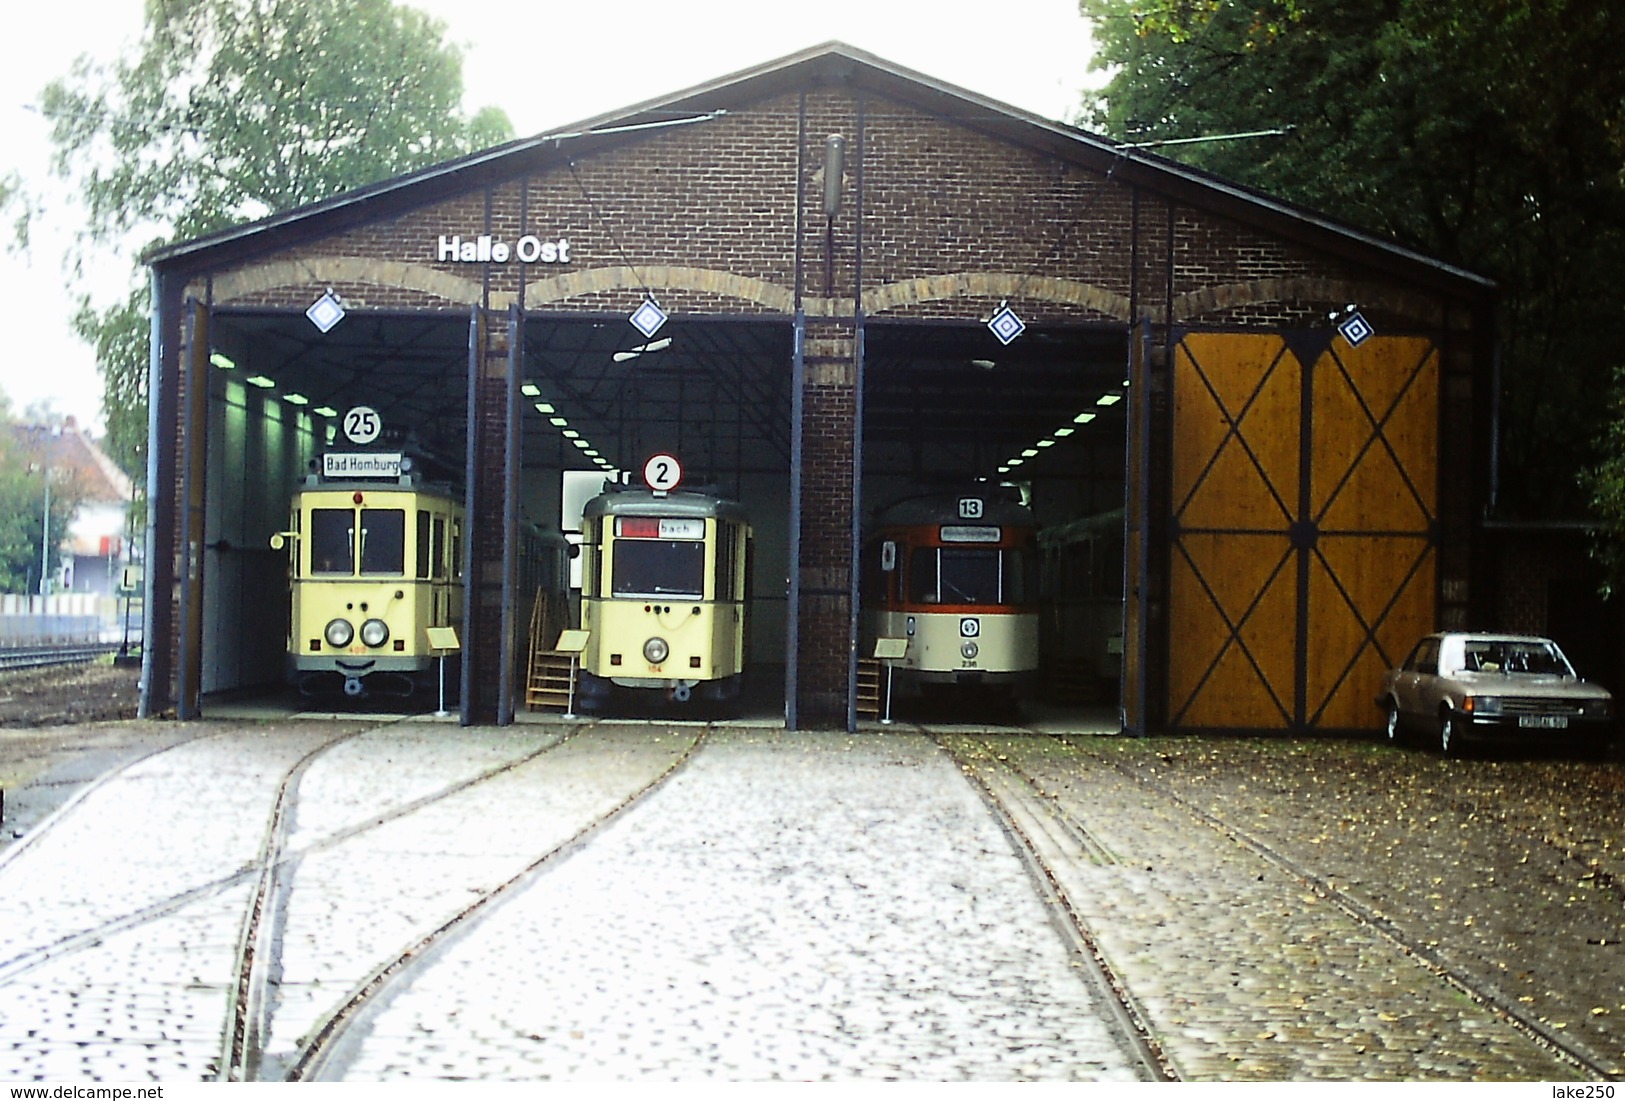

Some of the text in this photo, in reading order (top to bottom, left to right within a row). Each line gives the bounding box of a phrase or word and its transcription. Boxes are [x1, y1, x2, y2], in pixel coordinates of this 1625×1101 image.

[437, 234, 570, 263] Halle Ost
[350, 413, 375, 436] 25
[327, 457, 399, 475] Bad Homburg
[656, 462, 668, 483] 2
[961, 501, 979, 515] 13
